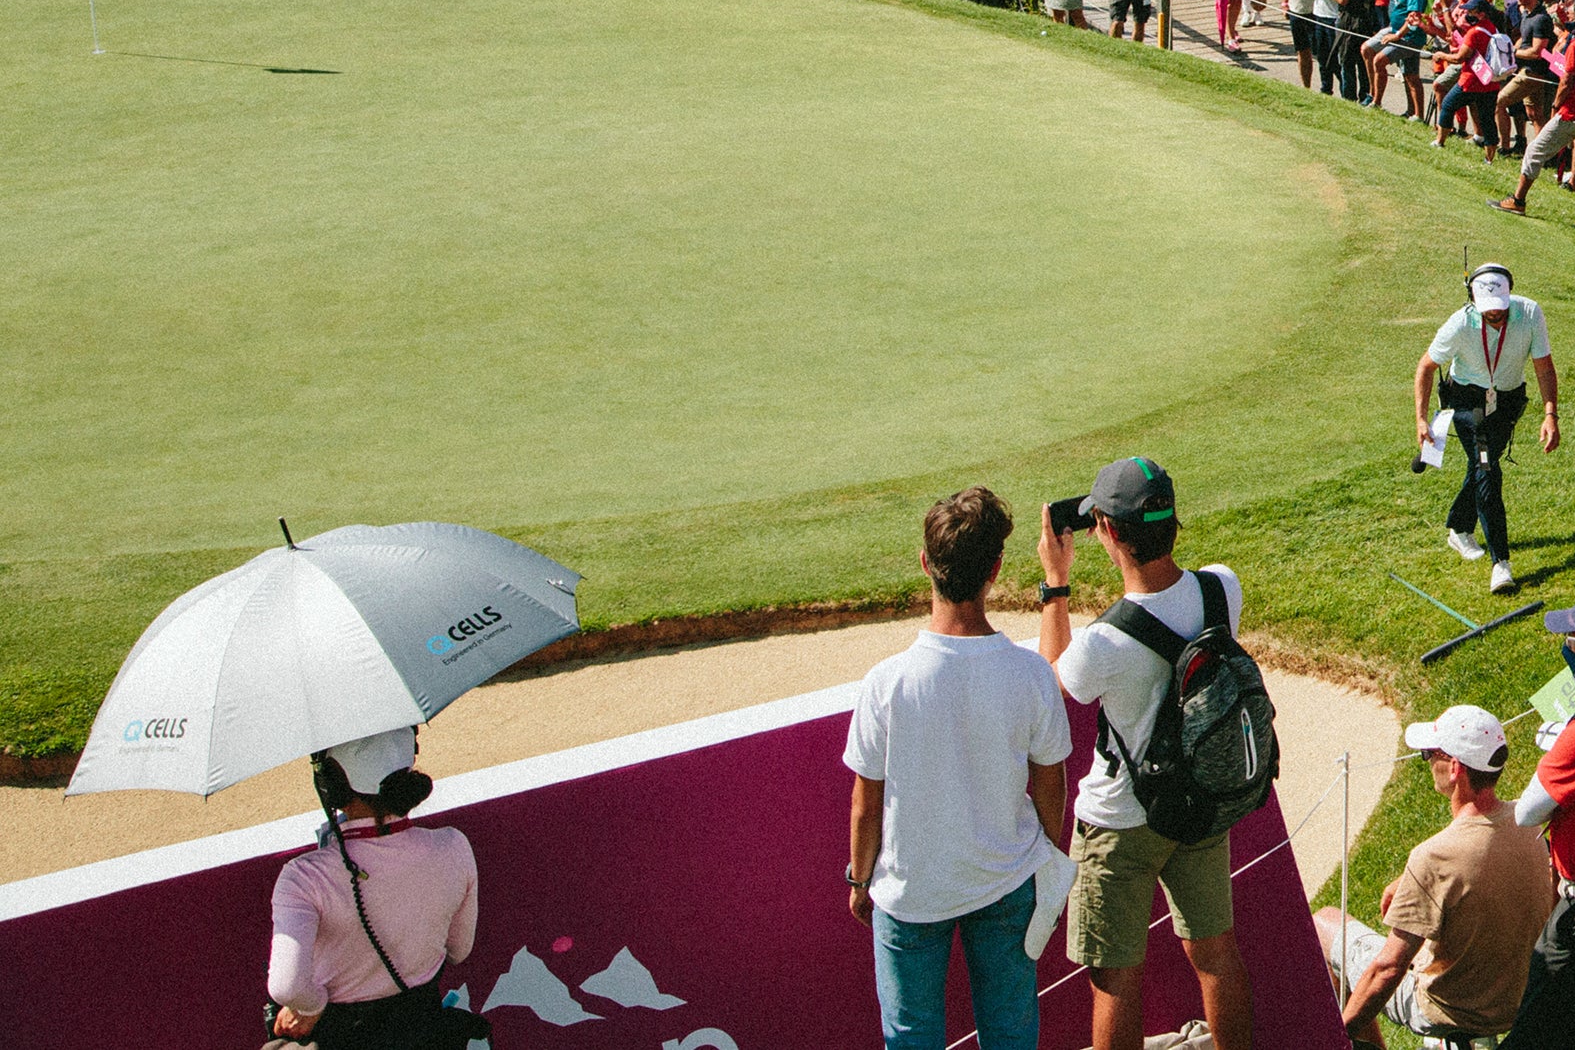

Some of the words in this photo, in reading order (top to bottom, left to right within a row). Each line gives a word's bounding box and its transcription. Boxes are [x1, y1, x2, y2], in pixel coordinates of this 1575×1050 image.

[447, 605, 503, 642] CELLS
[442, 641, 478, 666] Engineered
[482, 623, 513, 641] Germany
[144, 717, 188, 739] CELLS
